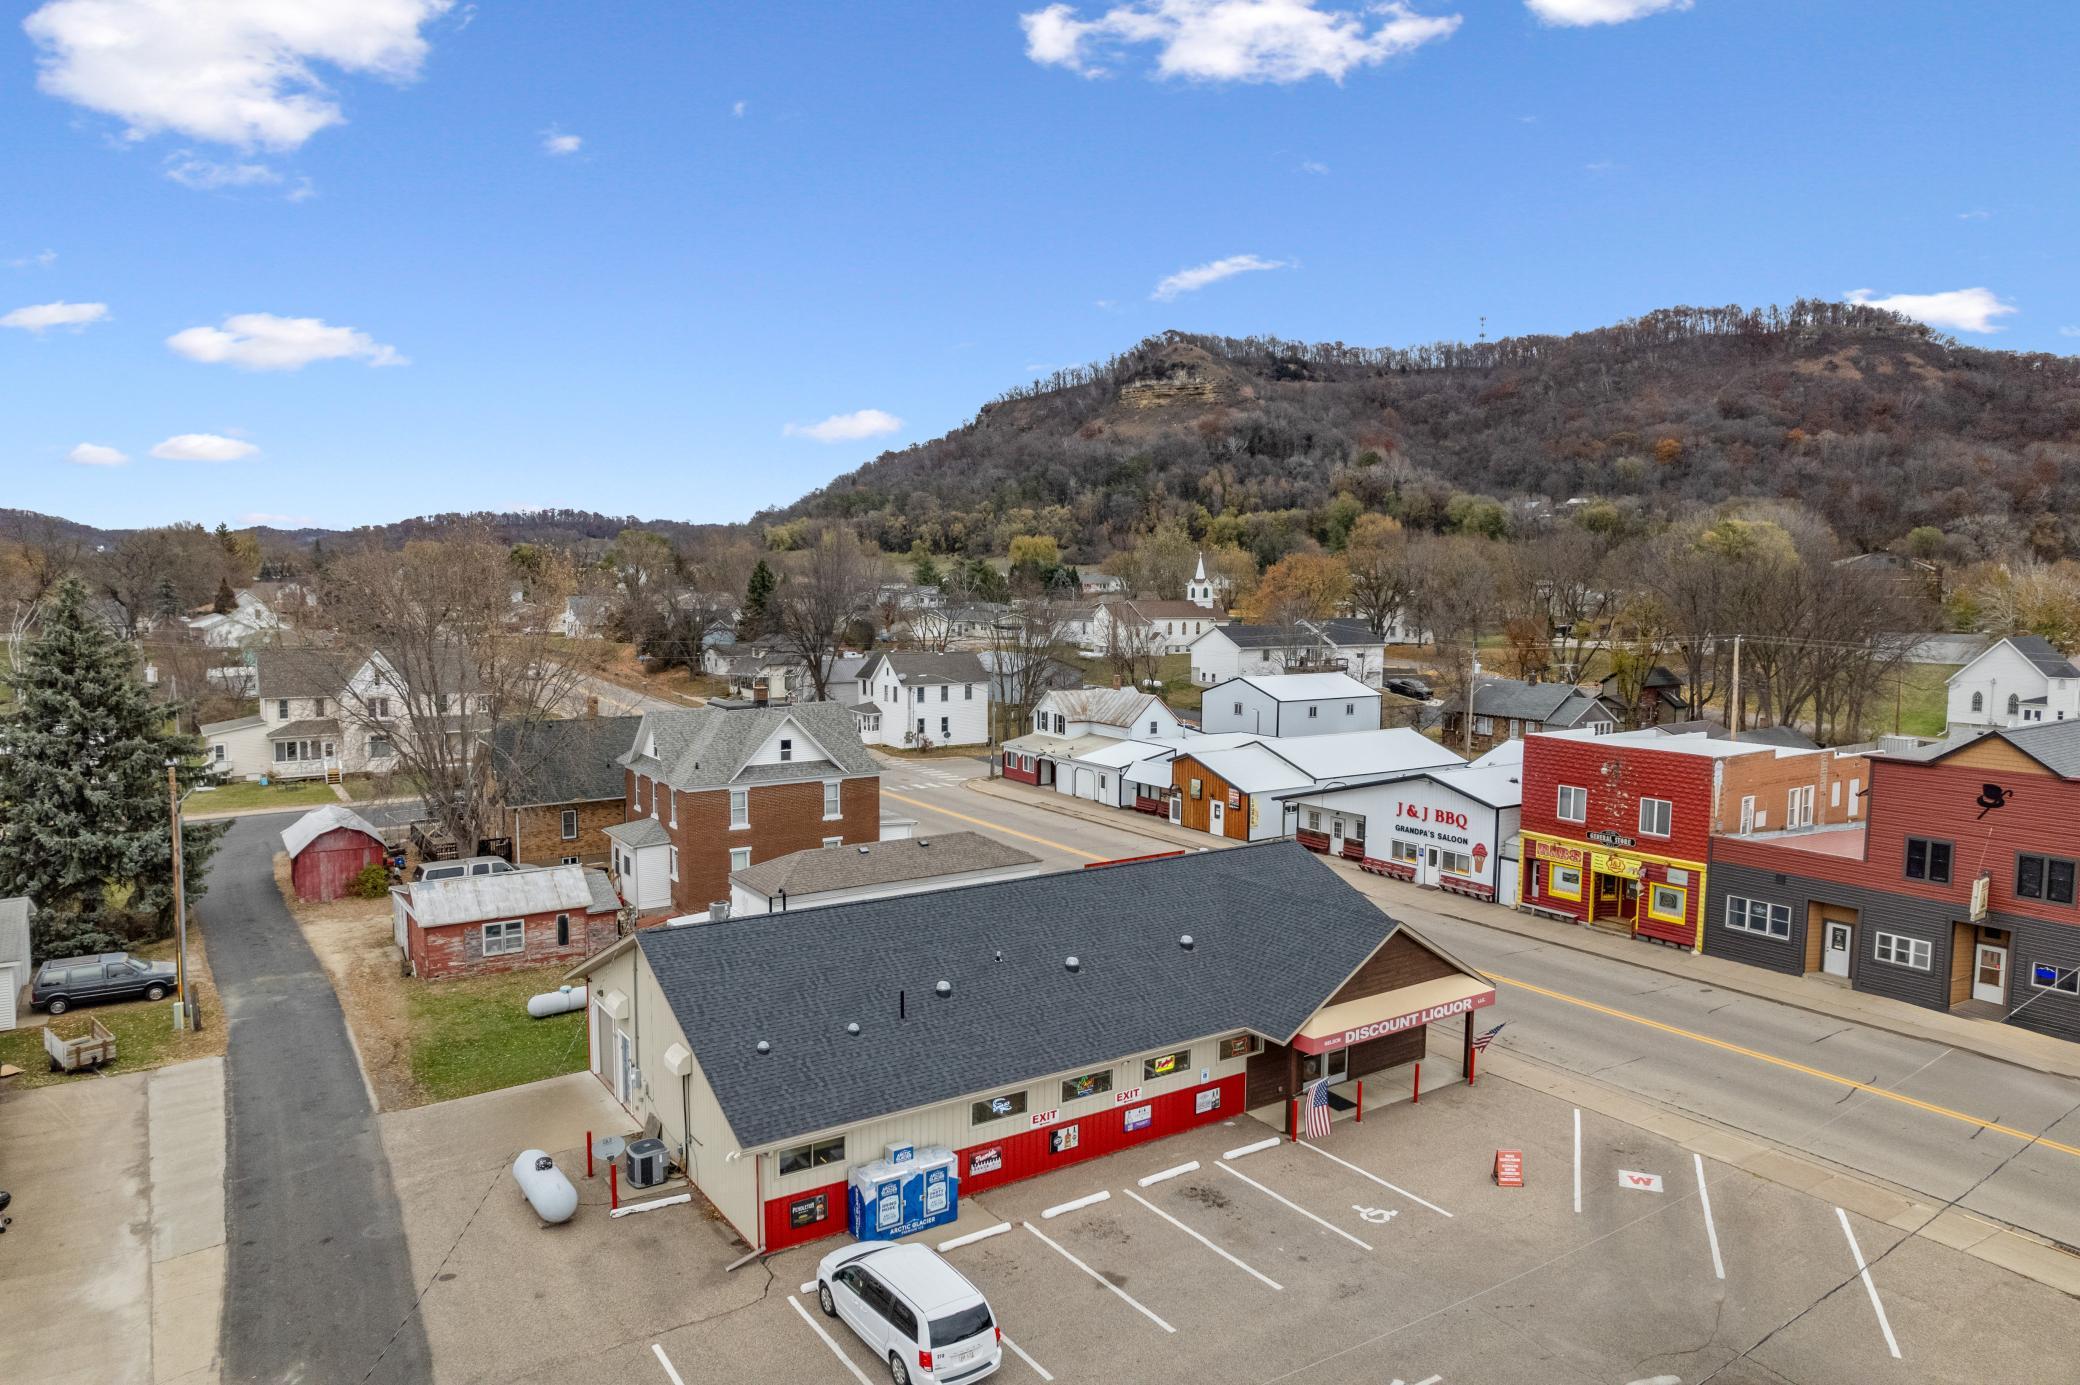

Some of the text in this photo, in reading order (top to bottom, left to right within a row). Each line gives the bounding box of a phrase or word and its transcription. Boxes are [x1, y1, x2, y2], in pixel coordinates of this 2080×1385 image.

[1396, 802, 1468, 830] J & J BBQ
[1395, 824, 1469, 845] GRANDPA'S SALOON
[1345, 1013, 1419, 1044] DISCOUNT
[1421, 998, 1473, 1022] LIQUOR
[1116, 1088, 1140, 1102] EXIT
[1032, 1110, 1058, 1125] EXIT
[890, 1223, 911, 1235] ARCTIC
[911, 1216, 936, 1229] GLACIER
